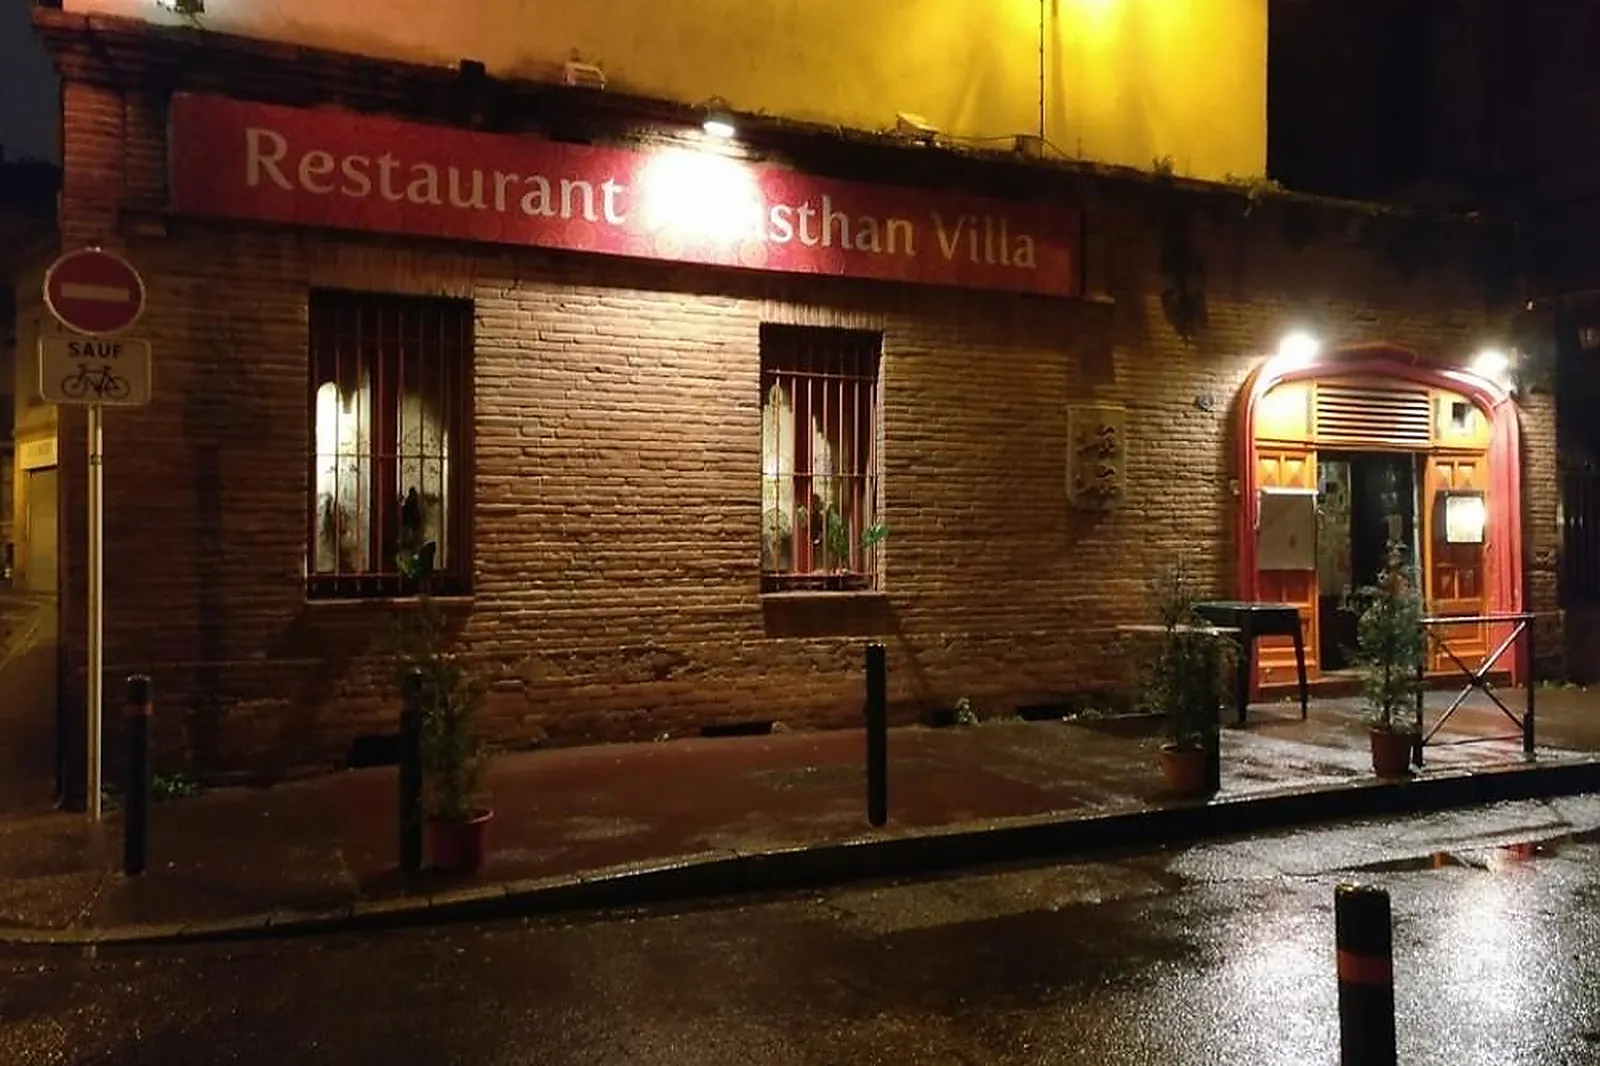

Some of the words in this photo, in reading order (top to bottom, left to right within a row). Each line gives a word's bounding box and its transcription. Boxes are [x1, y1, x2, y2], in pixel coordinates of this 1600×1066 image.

[245, 127, 626, 225] Restaurant
[931, 210, 1036, 269] Villa
[68, 341, 122, 359] SAUF
